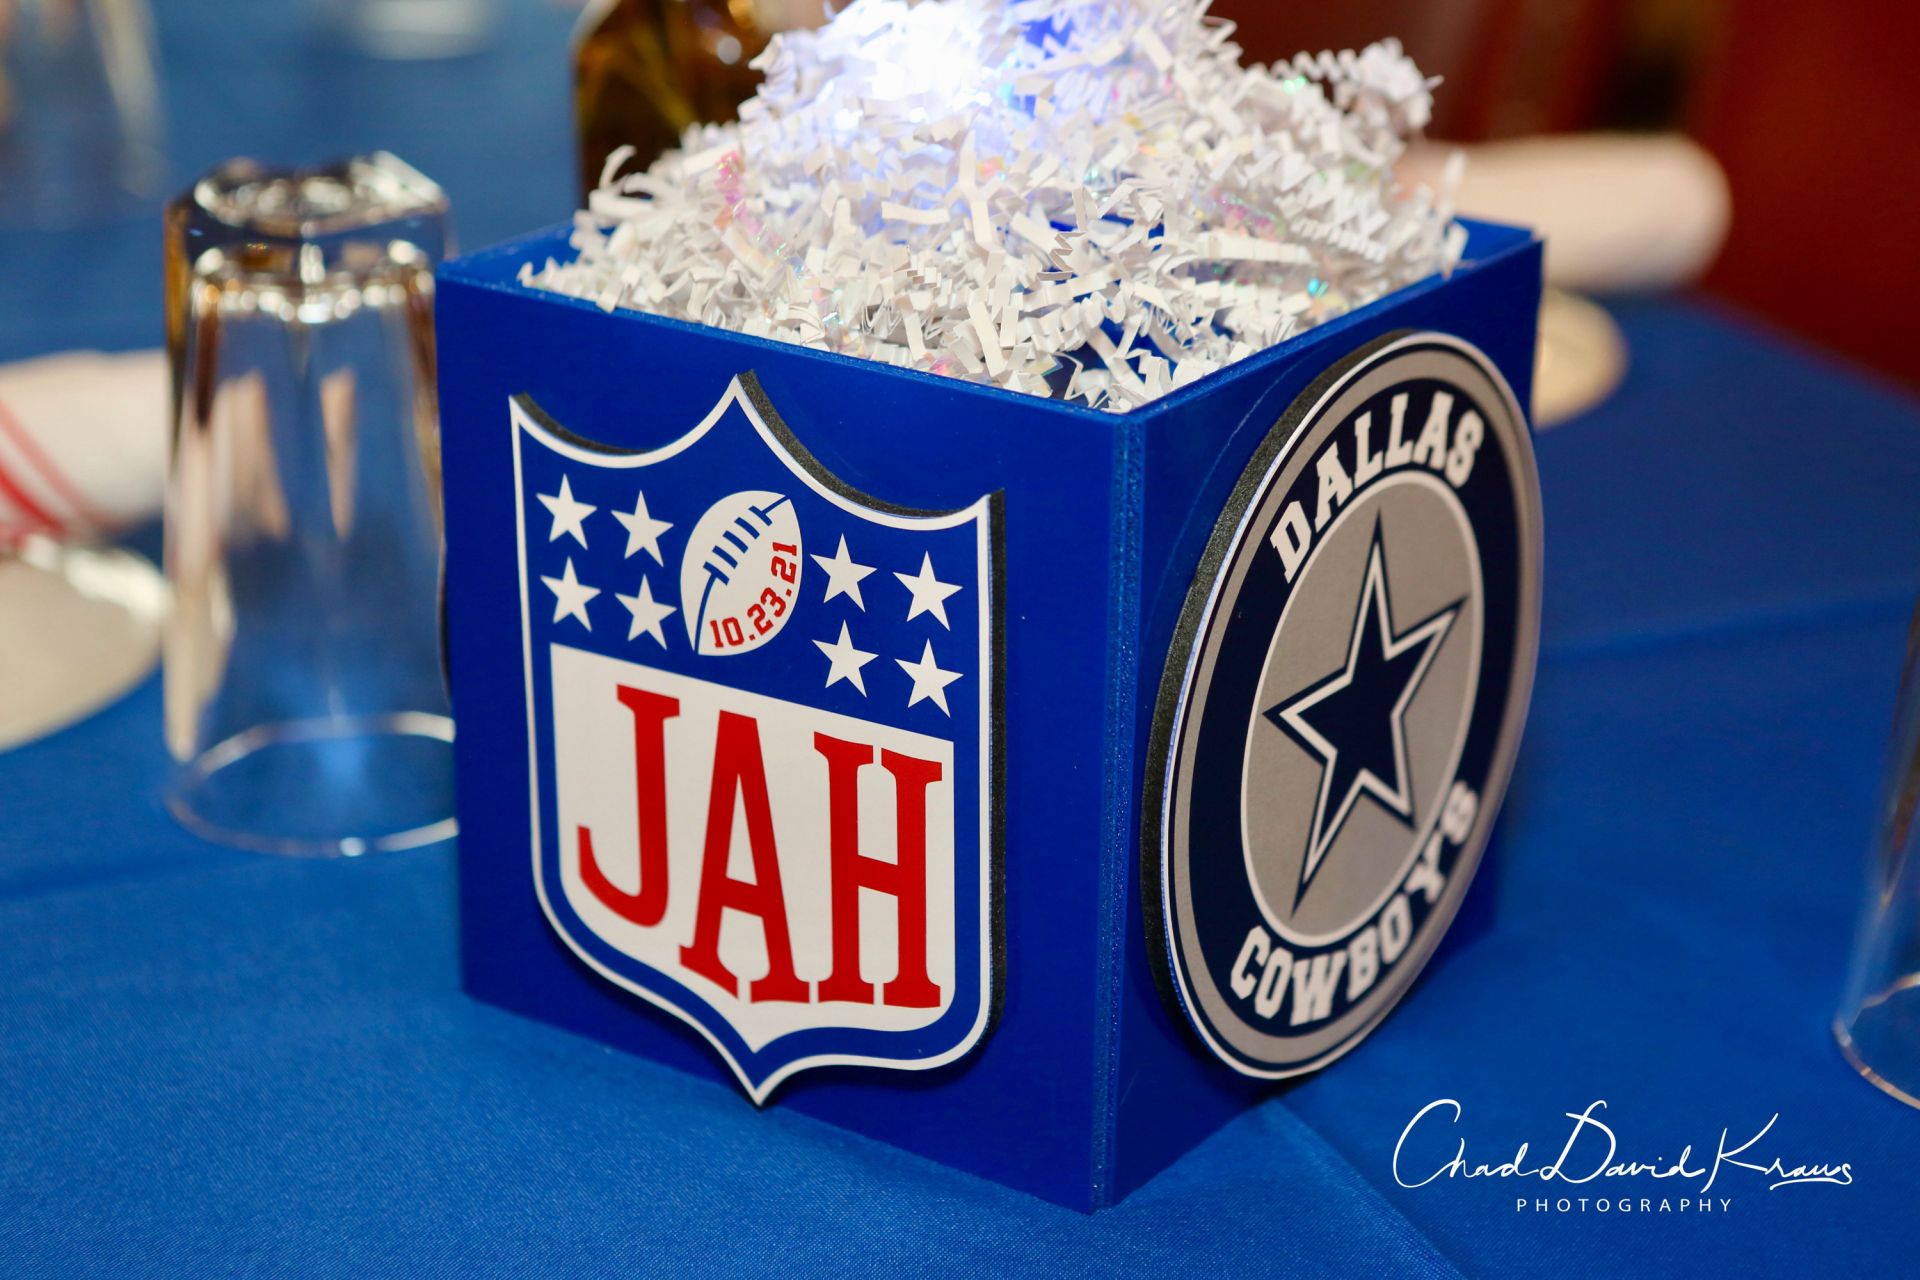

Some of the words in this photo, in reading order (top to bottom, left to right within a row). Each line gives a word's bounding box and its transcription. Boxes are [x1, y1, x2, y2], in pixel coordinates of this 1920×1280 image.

[709, 541, 798, 649] 10.23.21
[1269, 391, 1484, 583] DALLAS
[576, 682, 943, 1008] JAH
[1230, 779, 1480, 1028] COWBOYS
